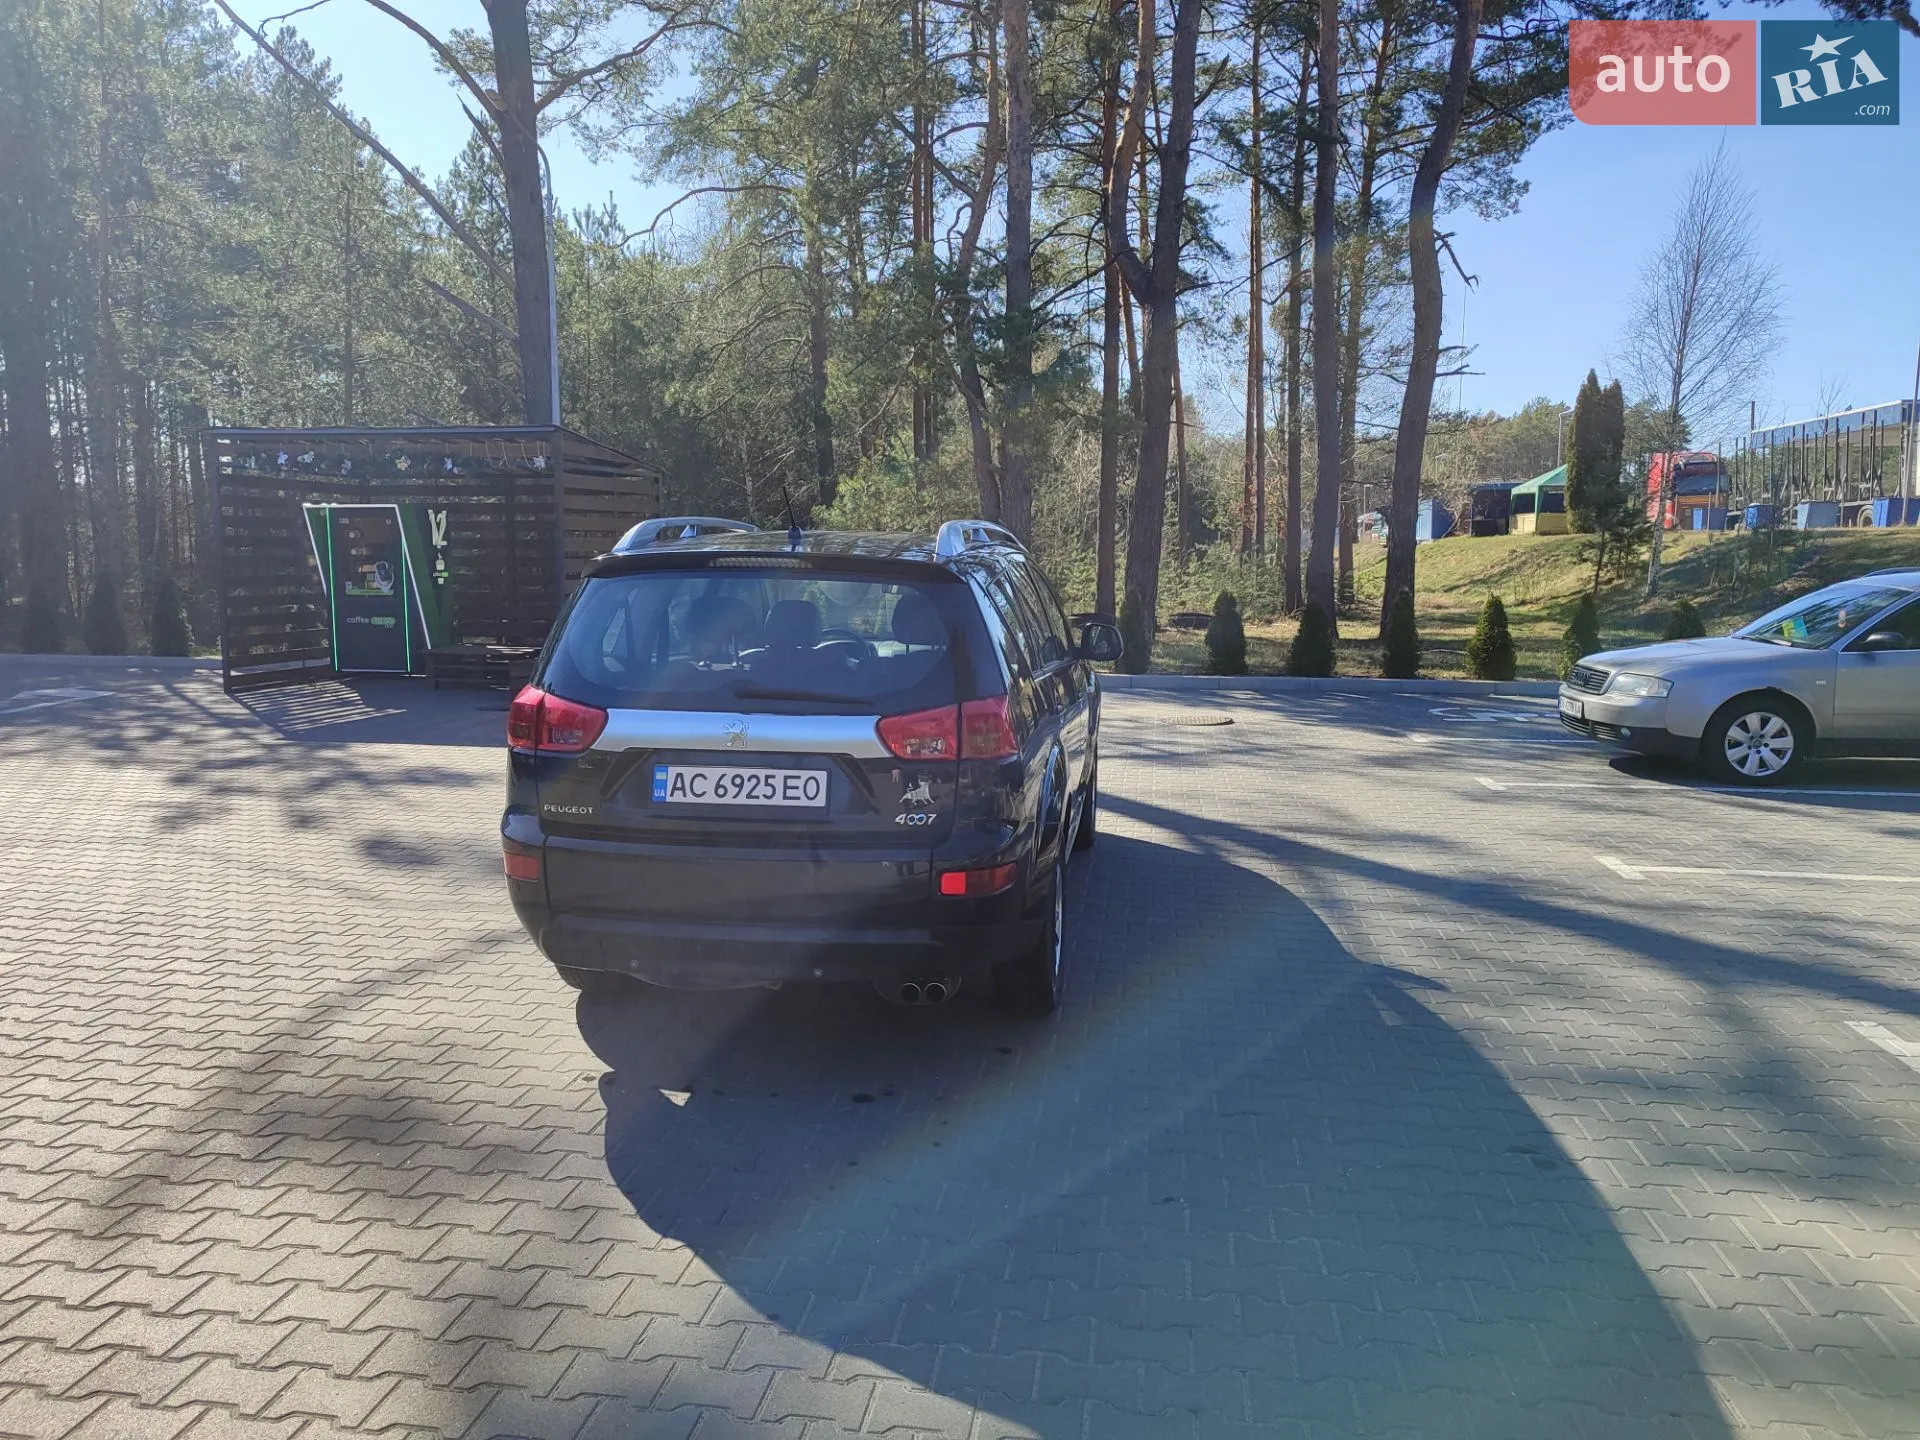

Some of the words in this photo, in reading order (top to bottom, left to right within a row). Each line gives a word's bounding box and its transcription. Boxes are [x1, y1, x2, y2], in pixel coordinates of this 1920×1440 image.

[669, 772, 708, 798] AC
[714, 773, 777, 800] 6925
[654, 789, 666, 797] UA
[543, 803, 594, 814] PEUGEOT
[895, 813, 937, 826] 4007
